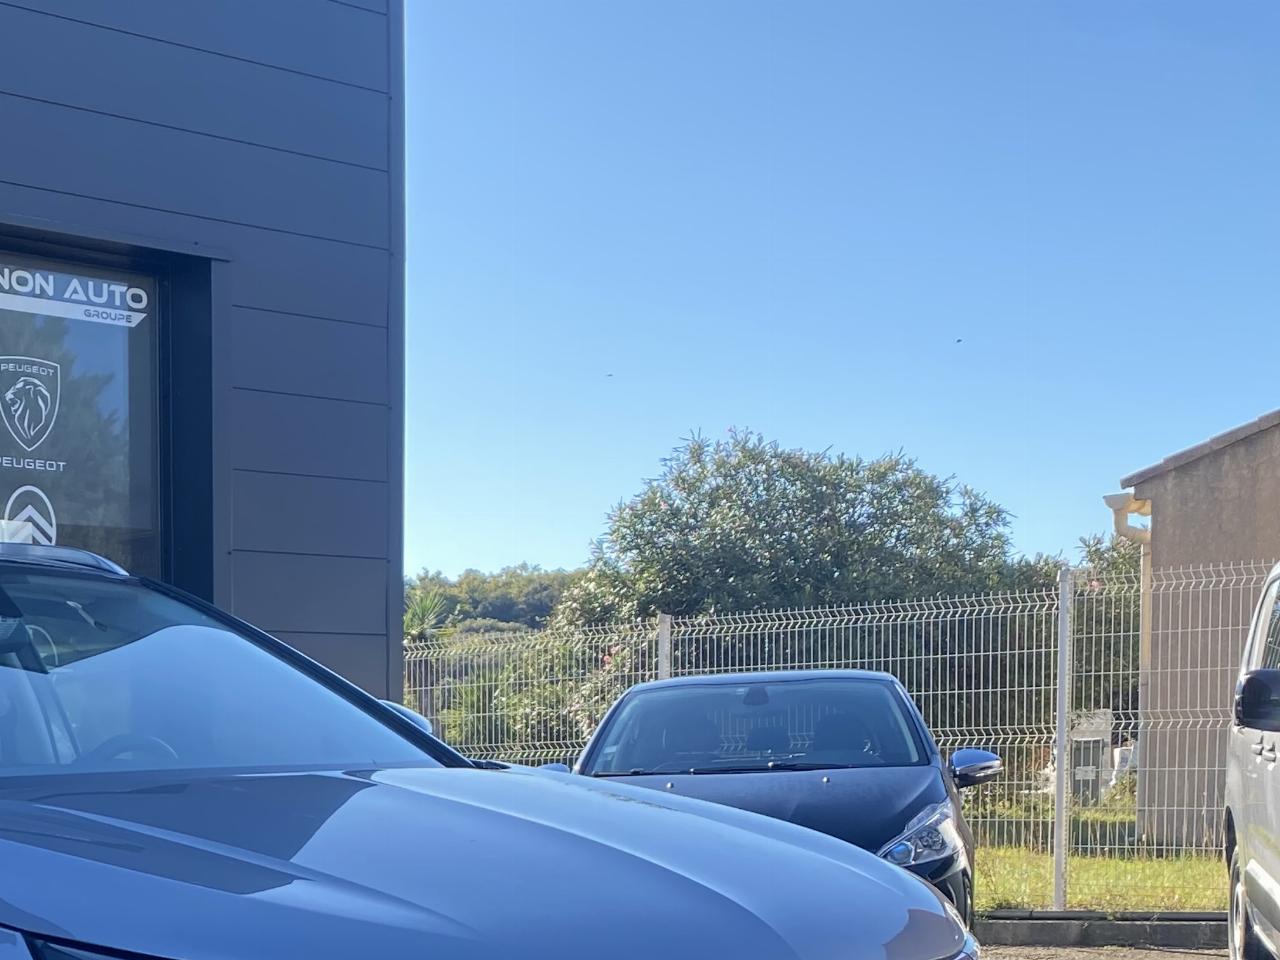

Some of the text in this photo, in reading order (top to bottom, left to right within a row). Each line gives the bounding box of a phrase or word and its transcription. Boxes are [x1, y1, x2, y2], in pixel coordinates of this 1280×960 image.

[63, 278, 148, 310] AUTO
[84, 308, 133, 324] GROUPE
[0, 363, 55, 377] PEUGEOT
